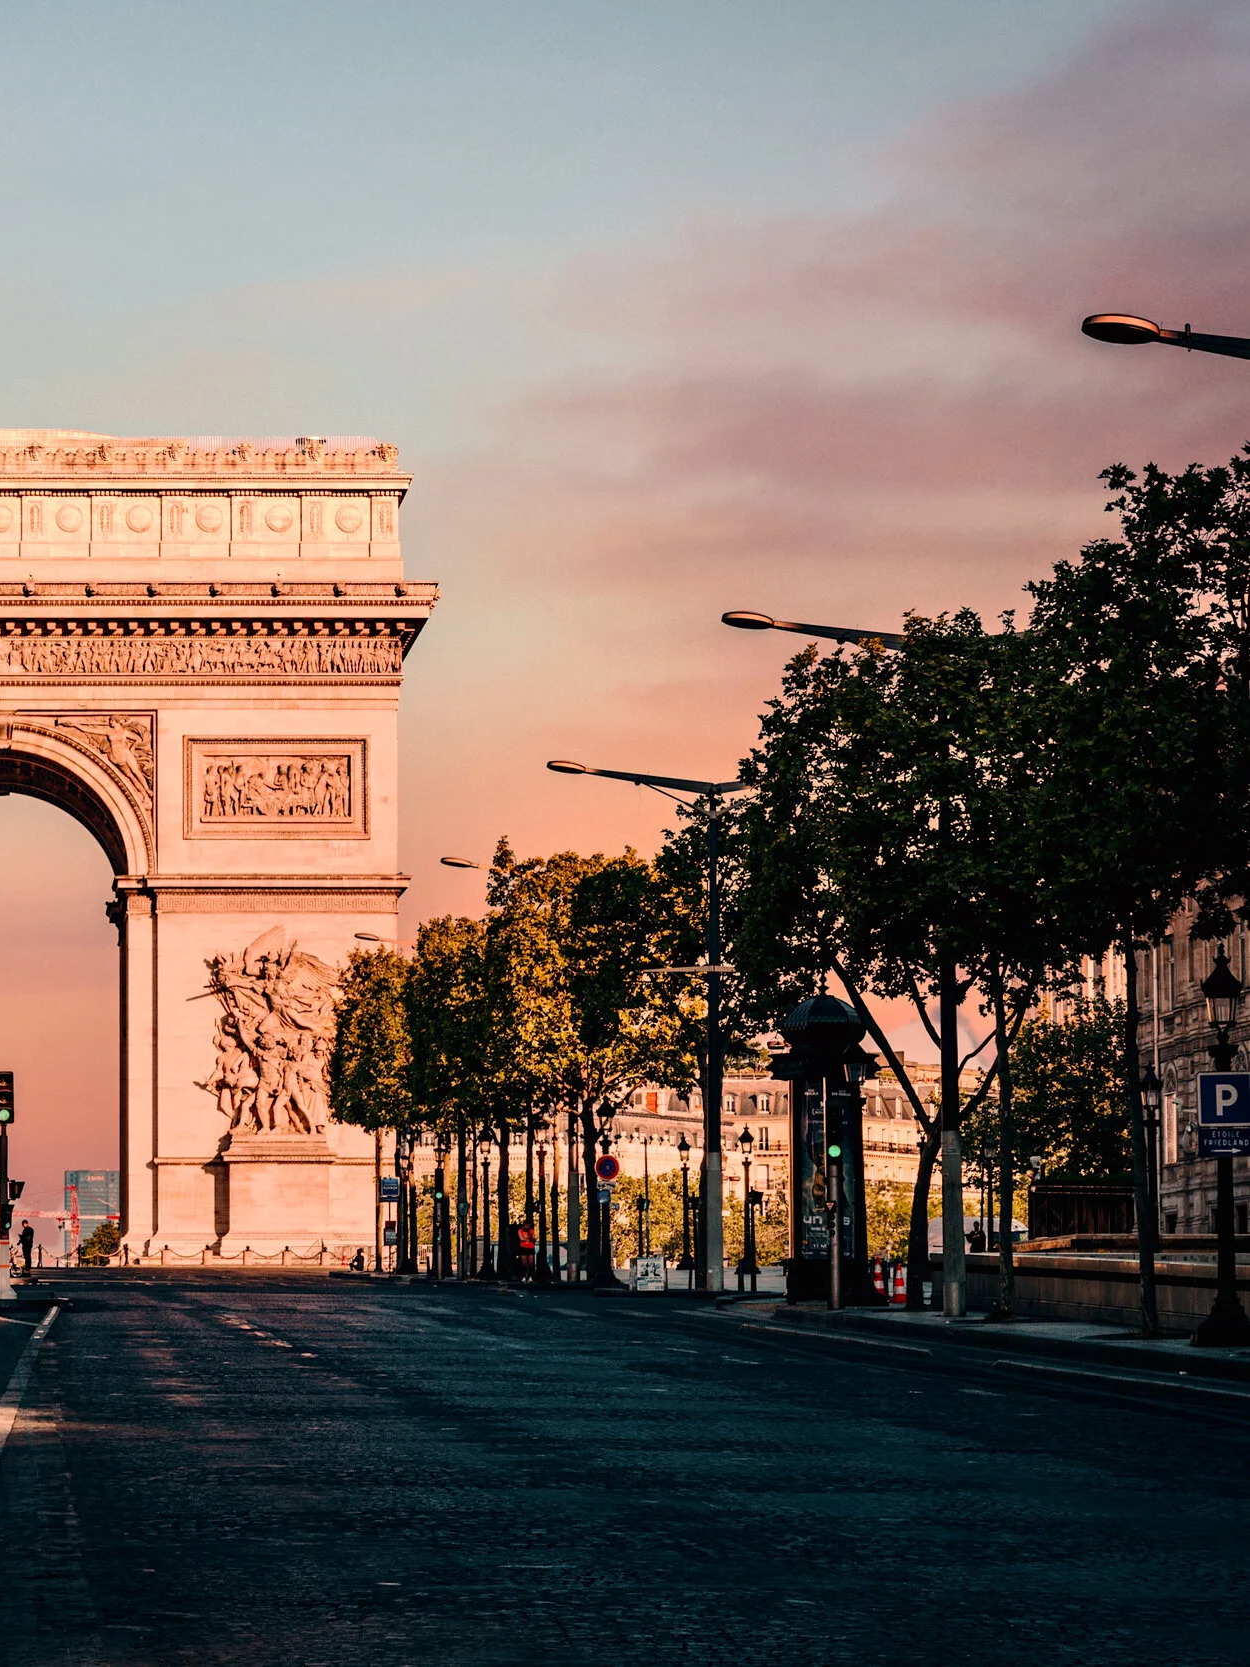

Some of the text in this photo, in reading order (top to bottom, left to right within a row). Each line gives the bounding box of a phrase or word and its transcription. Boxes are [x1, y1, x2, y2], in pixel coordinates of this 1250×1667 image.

[1215, 1084, 1238, 1116] P
[1212, 1130, 1240, 1138] ÉTOILE
[1203, 1139, 1249, 1147] FRIEDLAND
